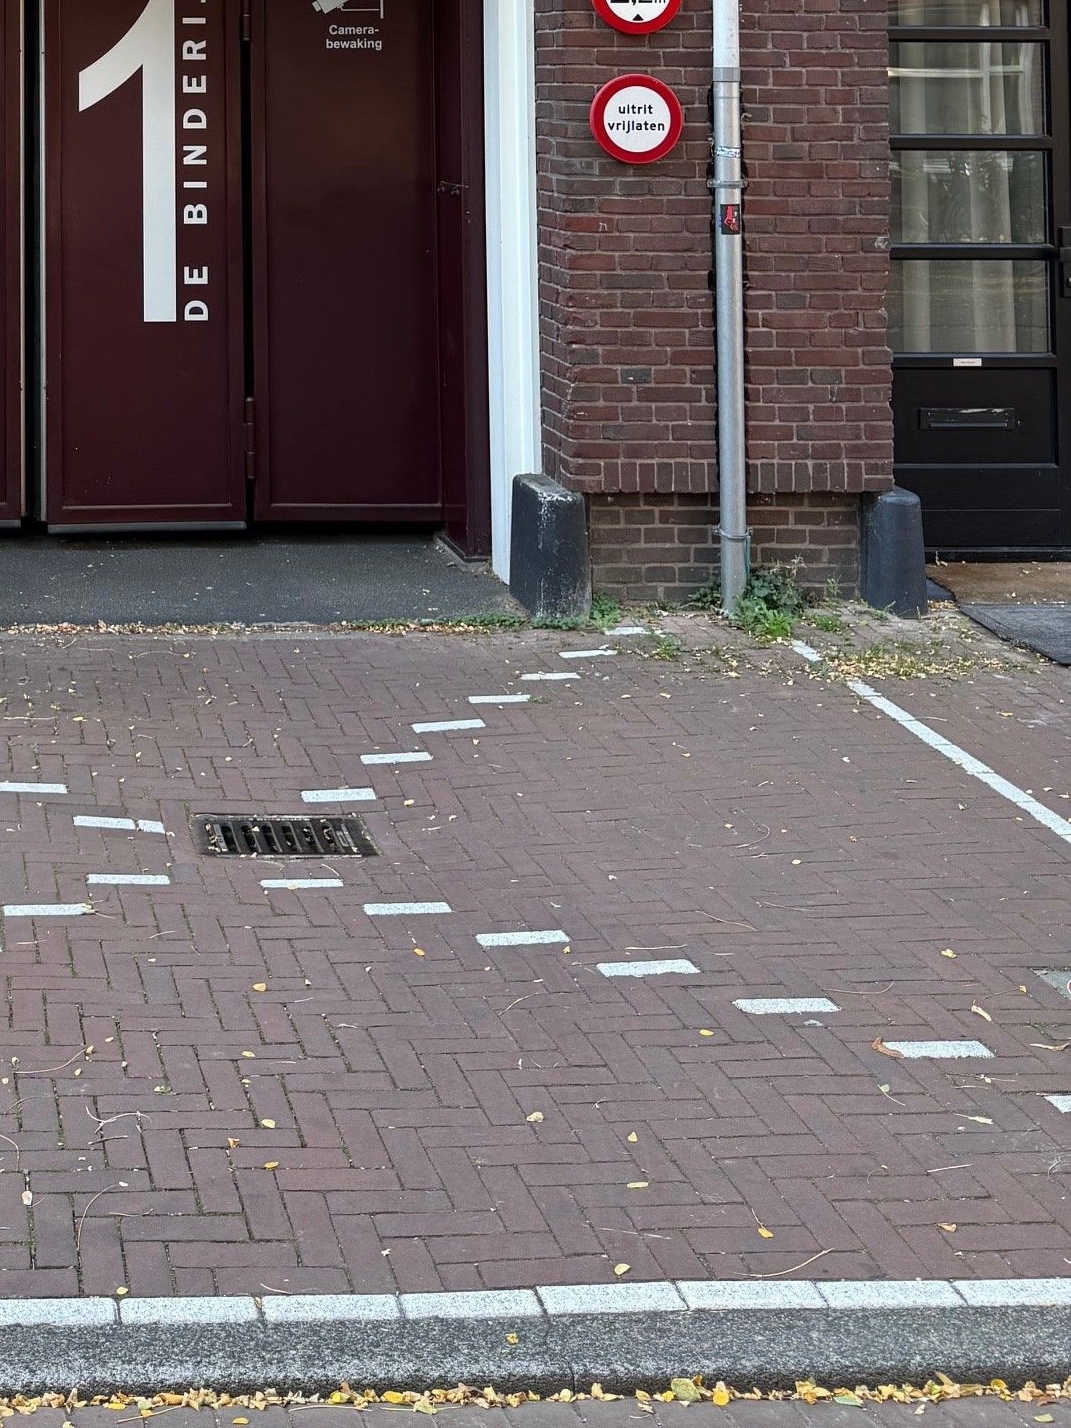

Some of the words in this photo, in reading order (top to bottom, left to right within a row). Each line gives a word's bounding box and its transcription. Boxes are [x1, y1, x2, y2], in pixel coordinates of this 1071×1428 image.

[329, 24, 379, 35] Camera-
[325, 38, 383, 51] bewaking
[618, 104, 654, 115] uitrit
[608, 120, 666, 134] vrijlaten
[184, 266, 209, 322] DE
